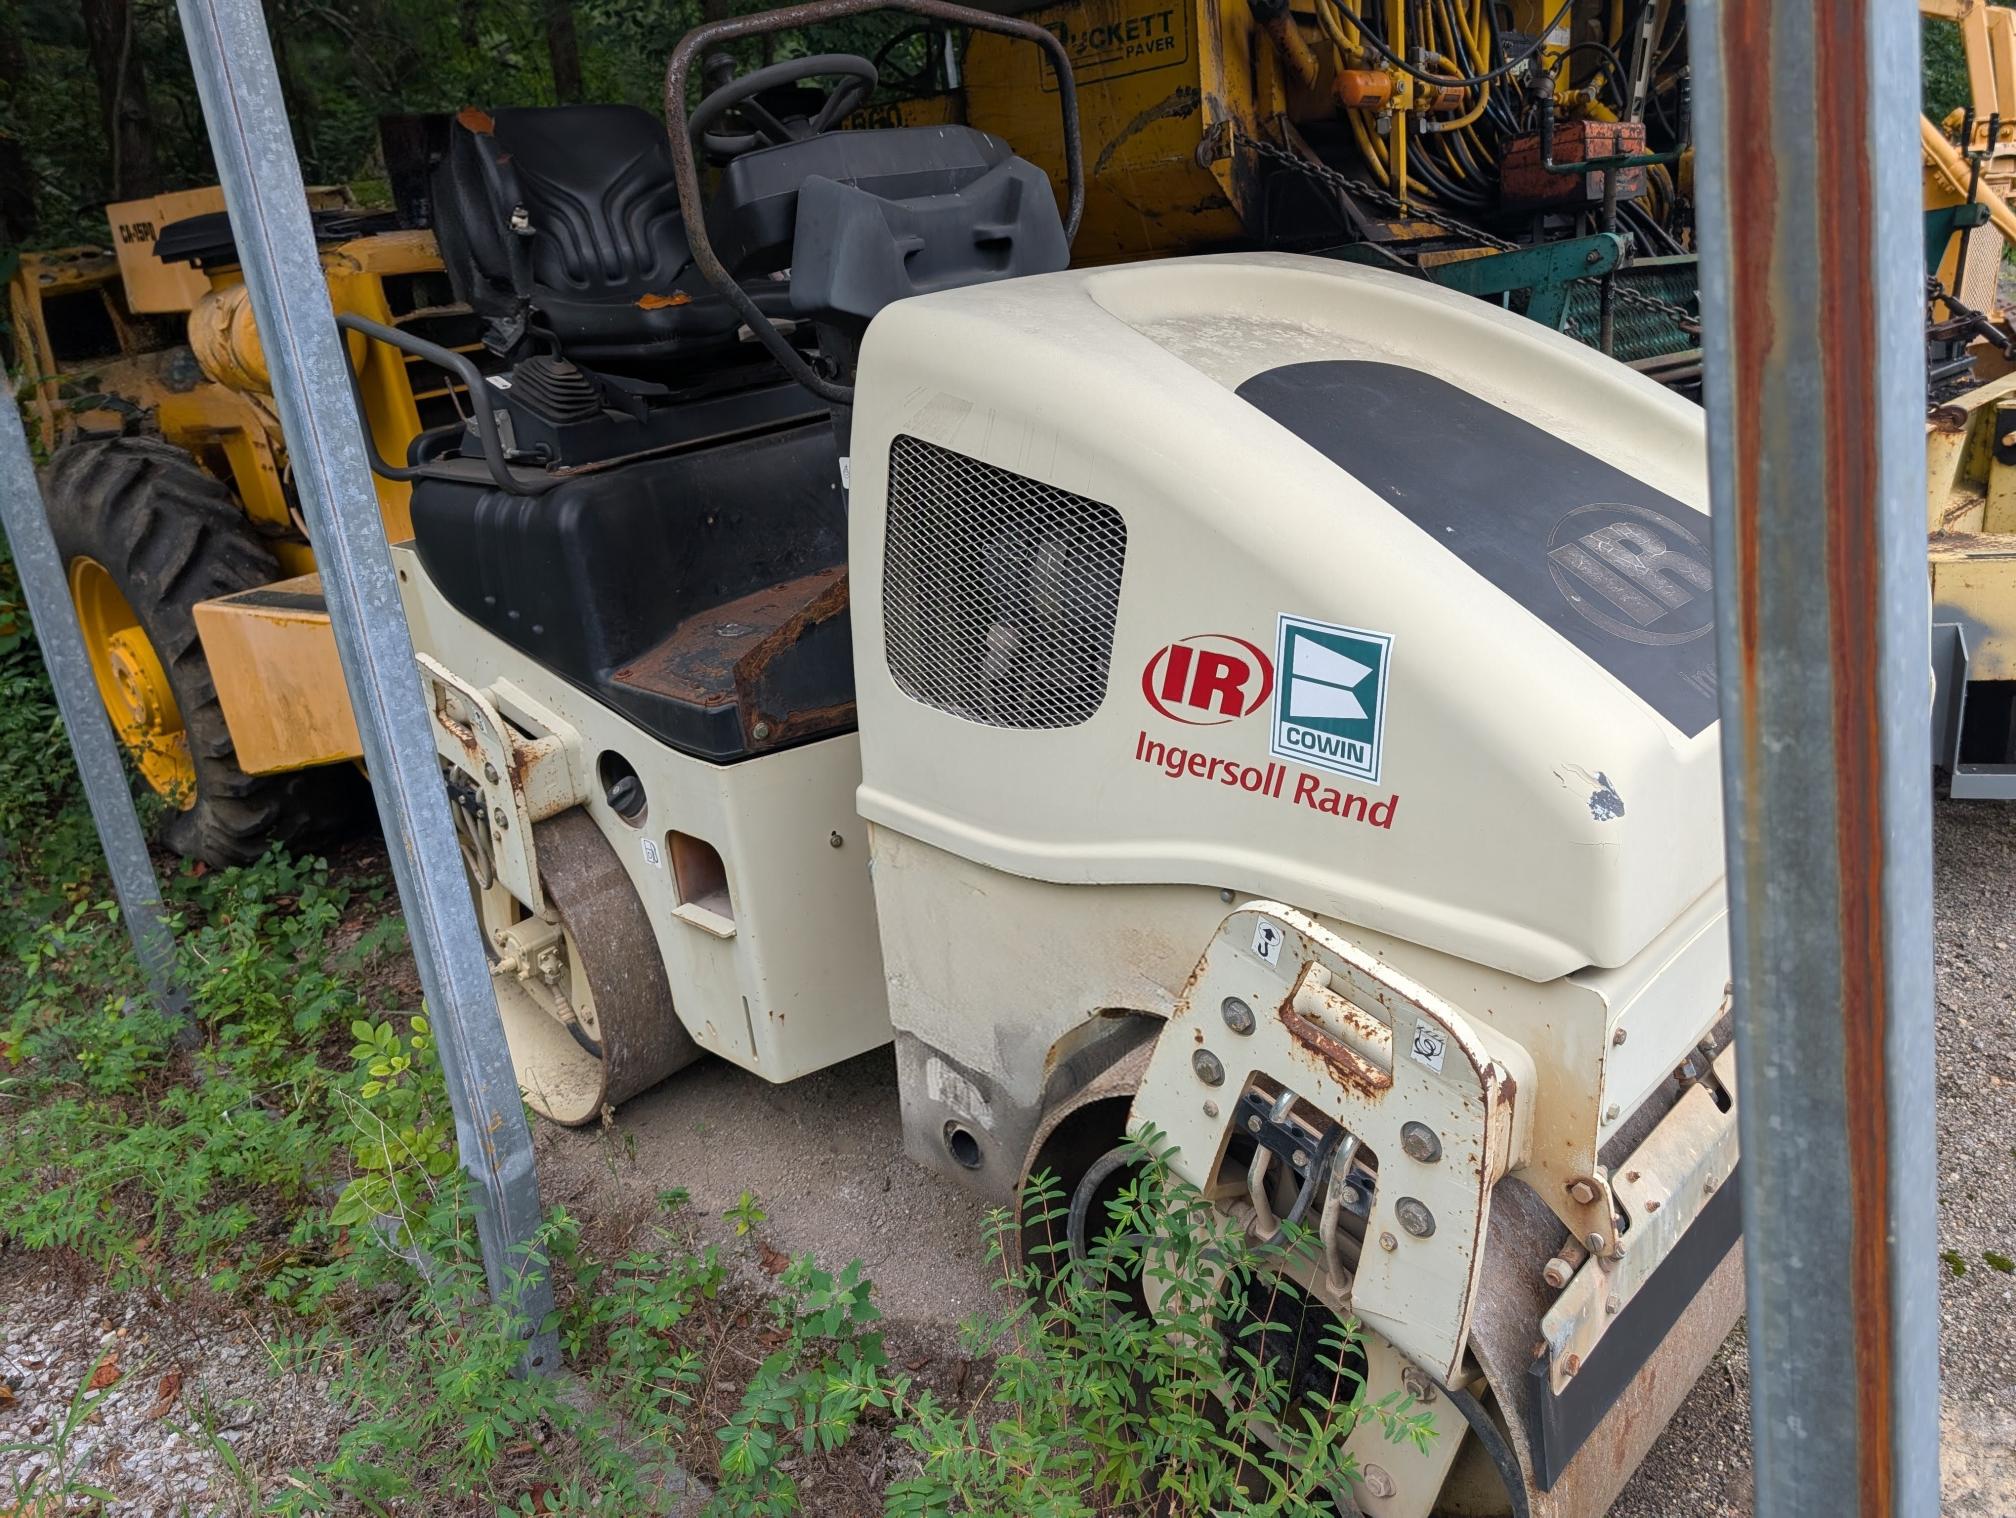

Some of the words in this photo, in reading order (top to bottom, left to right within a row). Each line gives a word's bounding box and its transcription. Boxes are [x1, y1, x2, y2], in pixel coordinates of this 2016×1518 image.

[1126, 36, 1175, 58] PAVER
[1161, 643, 1251, 718] IR
[1286, 727, 1365, 764] COWIN
[1135, 730, 1287, 799] Ingersoll
[1293, 772, 1399, 830] Rand
